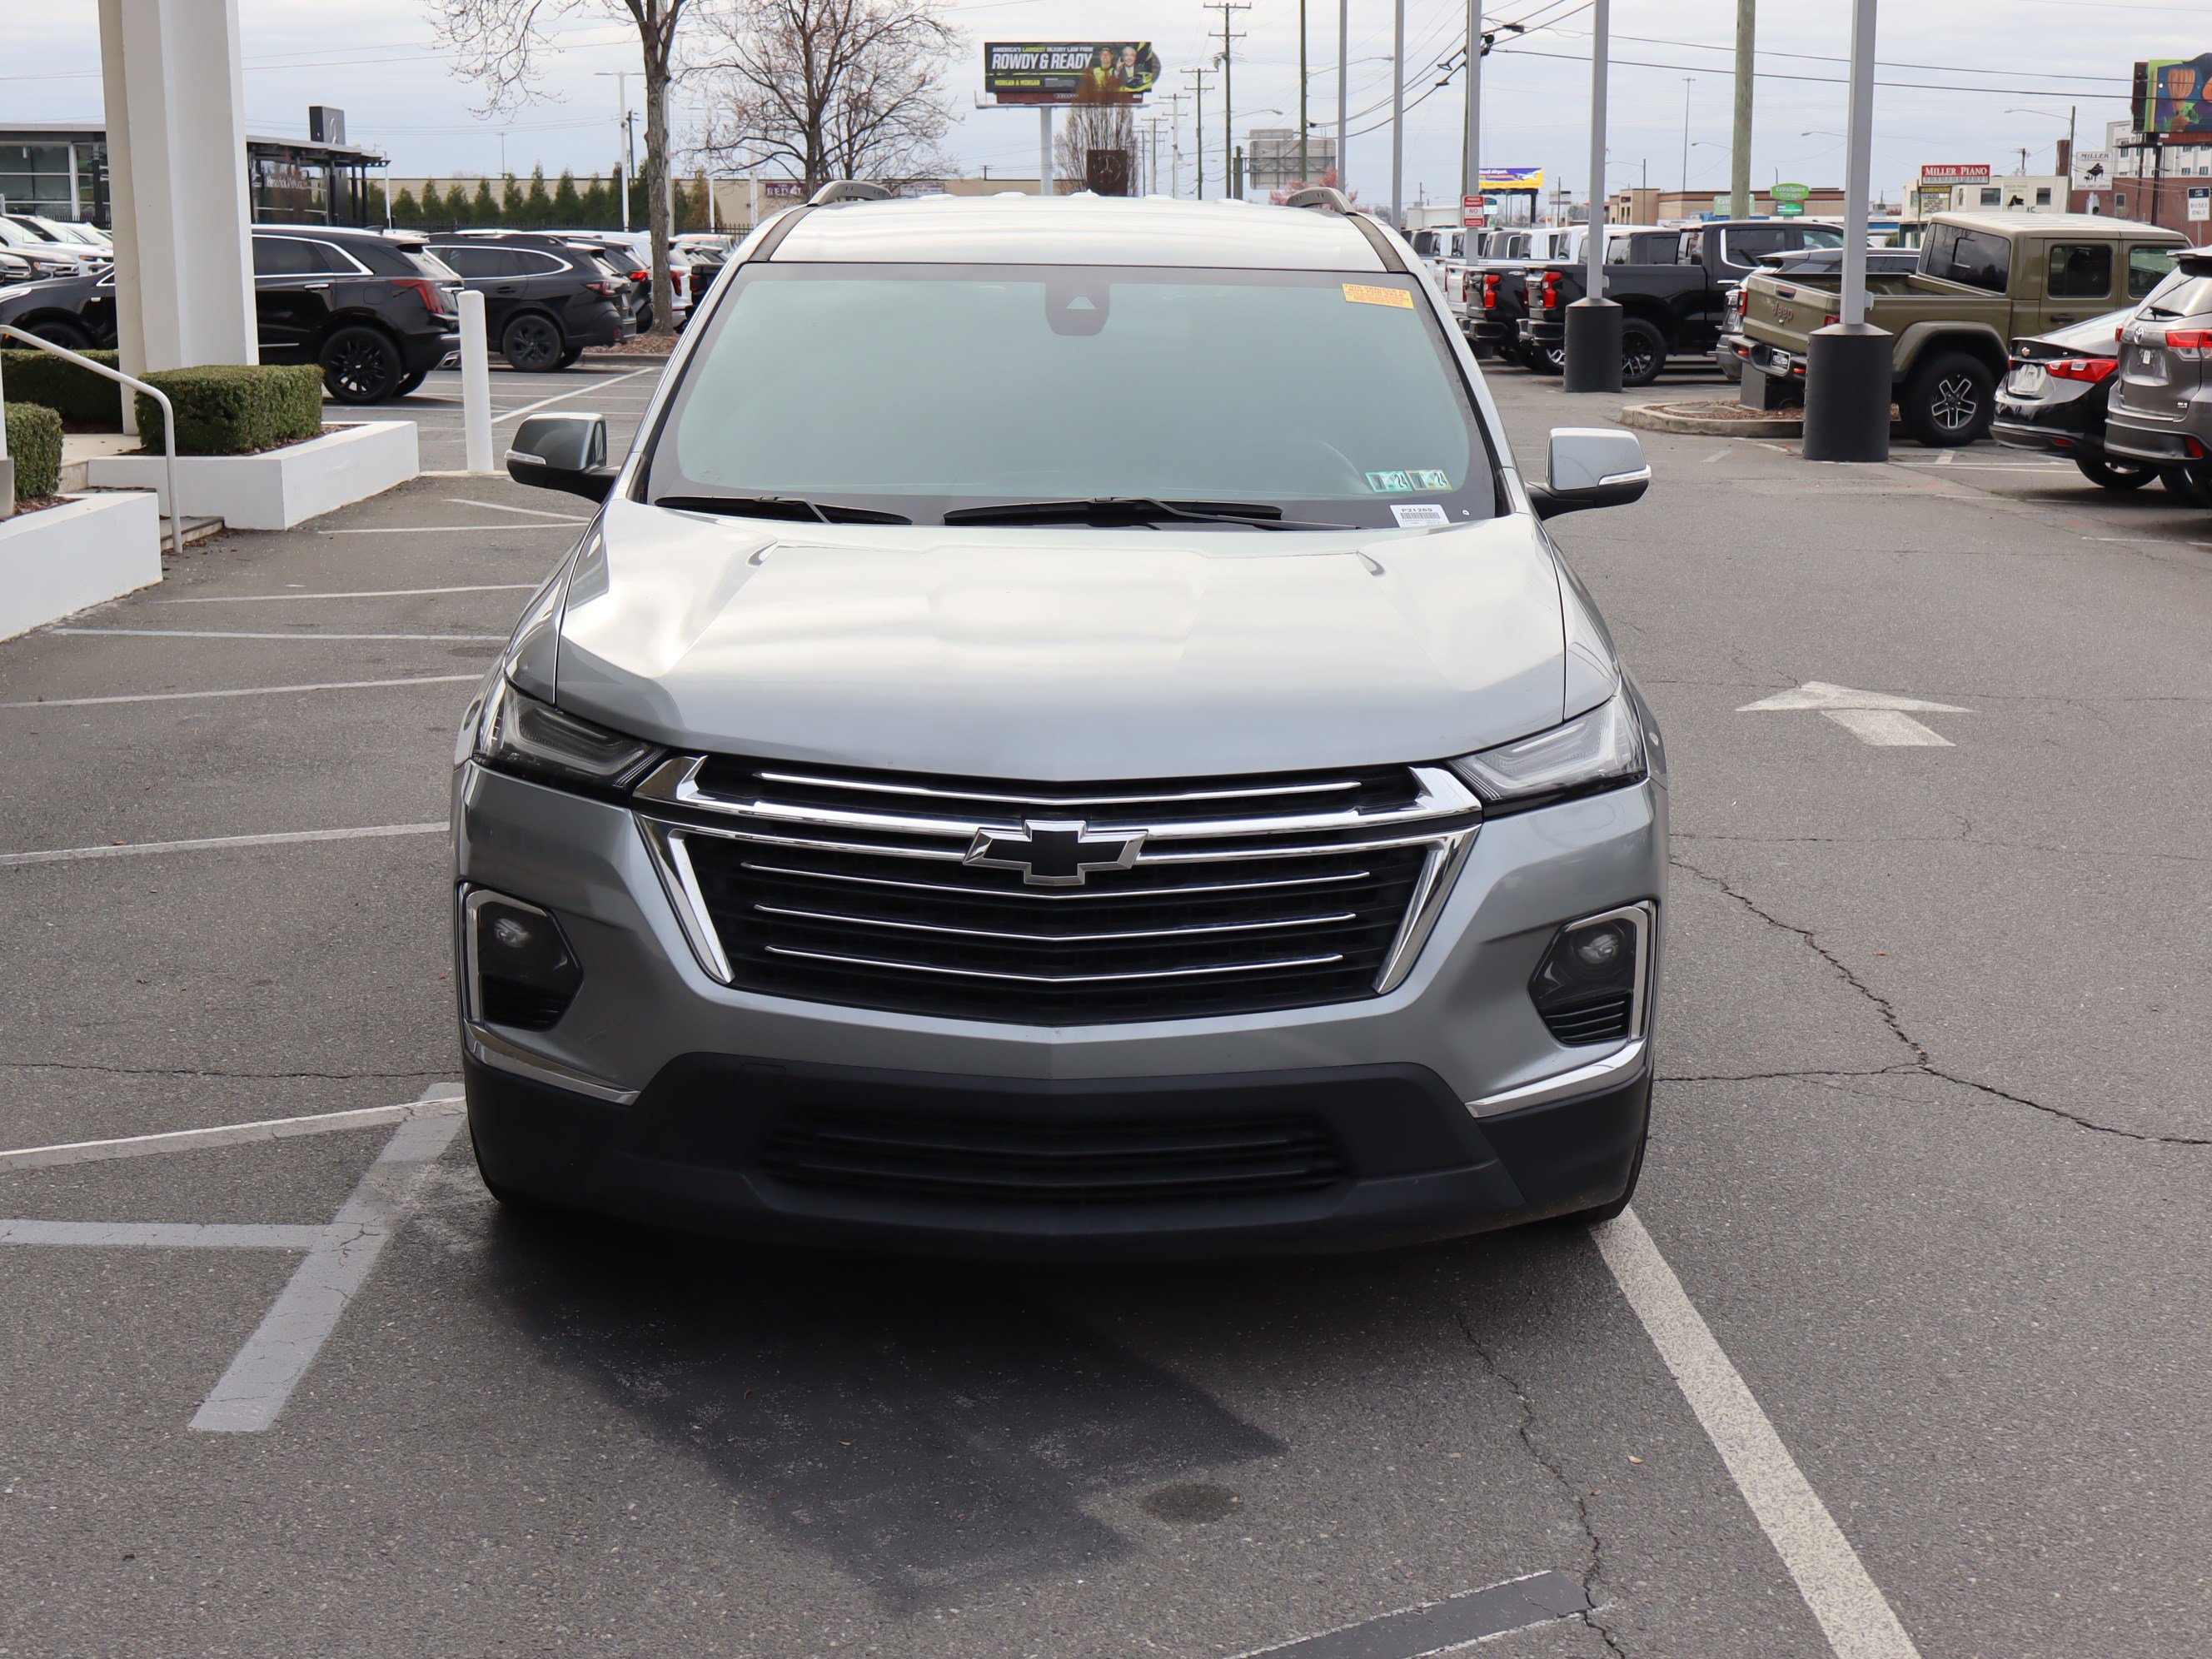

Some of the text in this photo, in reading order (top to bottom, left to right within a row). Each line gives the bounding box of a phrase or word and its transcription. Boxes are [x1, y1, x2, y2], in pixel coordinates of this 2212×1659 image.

[992, 53, 1093, 69] ROWDY & READY
[1925, 167, 1987, 176] MILLER PIANO
[767, 187, 789, 197] RED
[1772, 301, 1794, 322] Jeep
